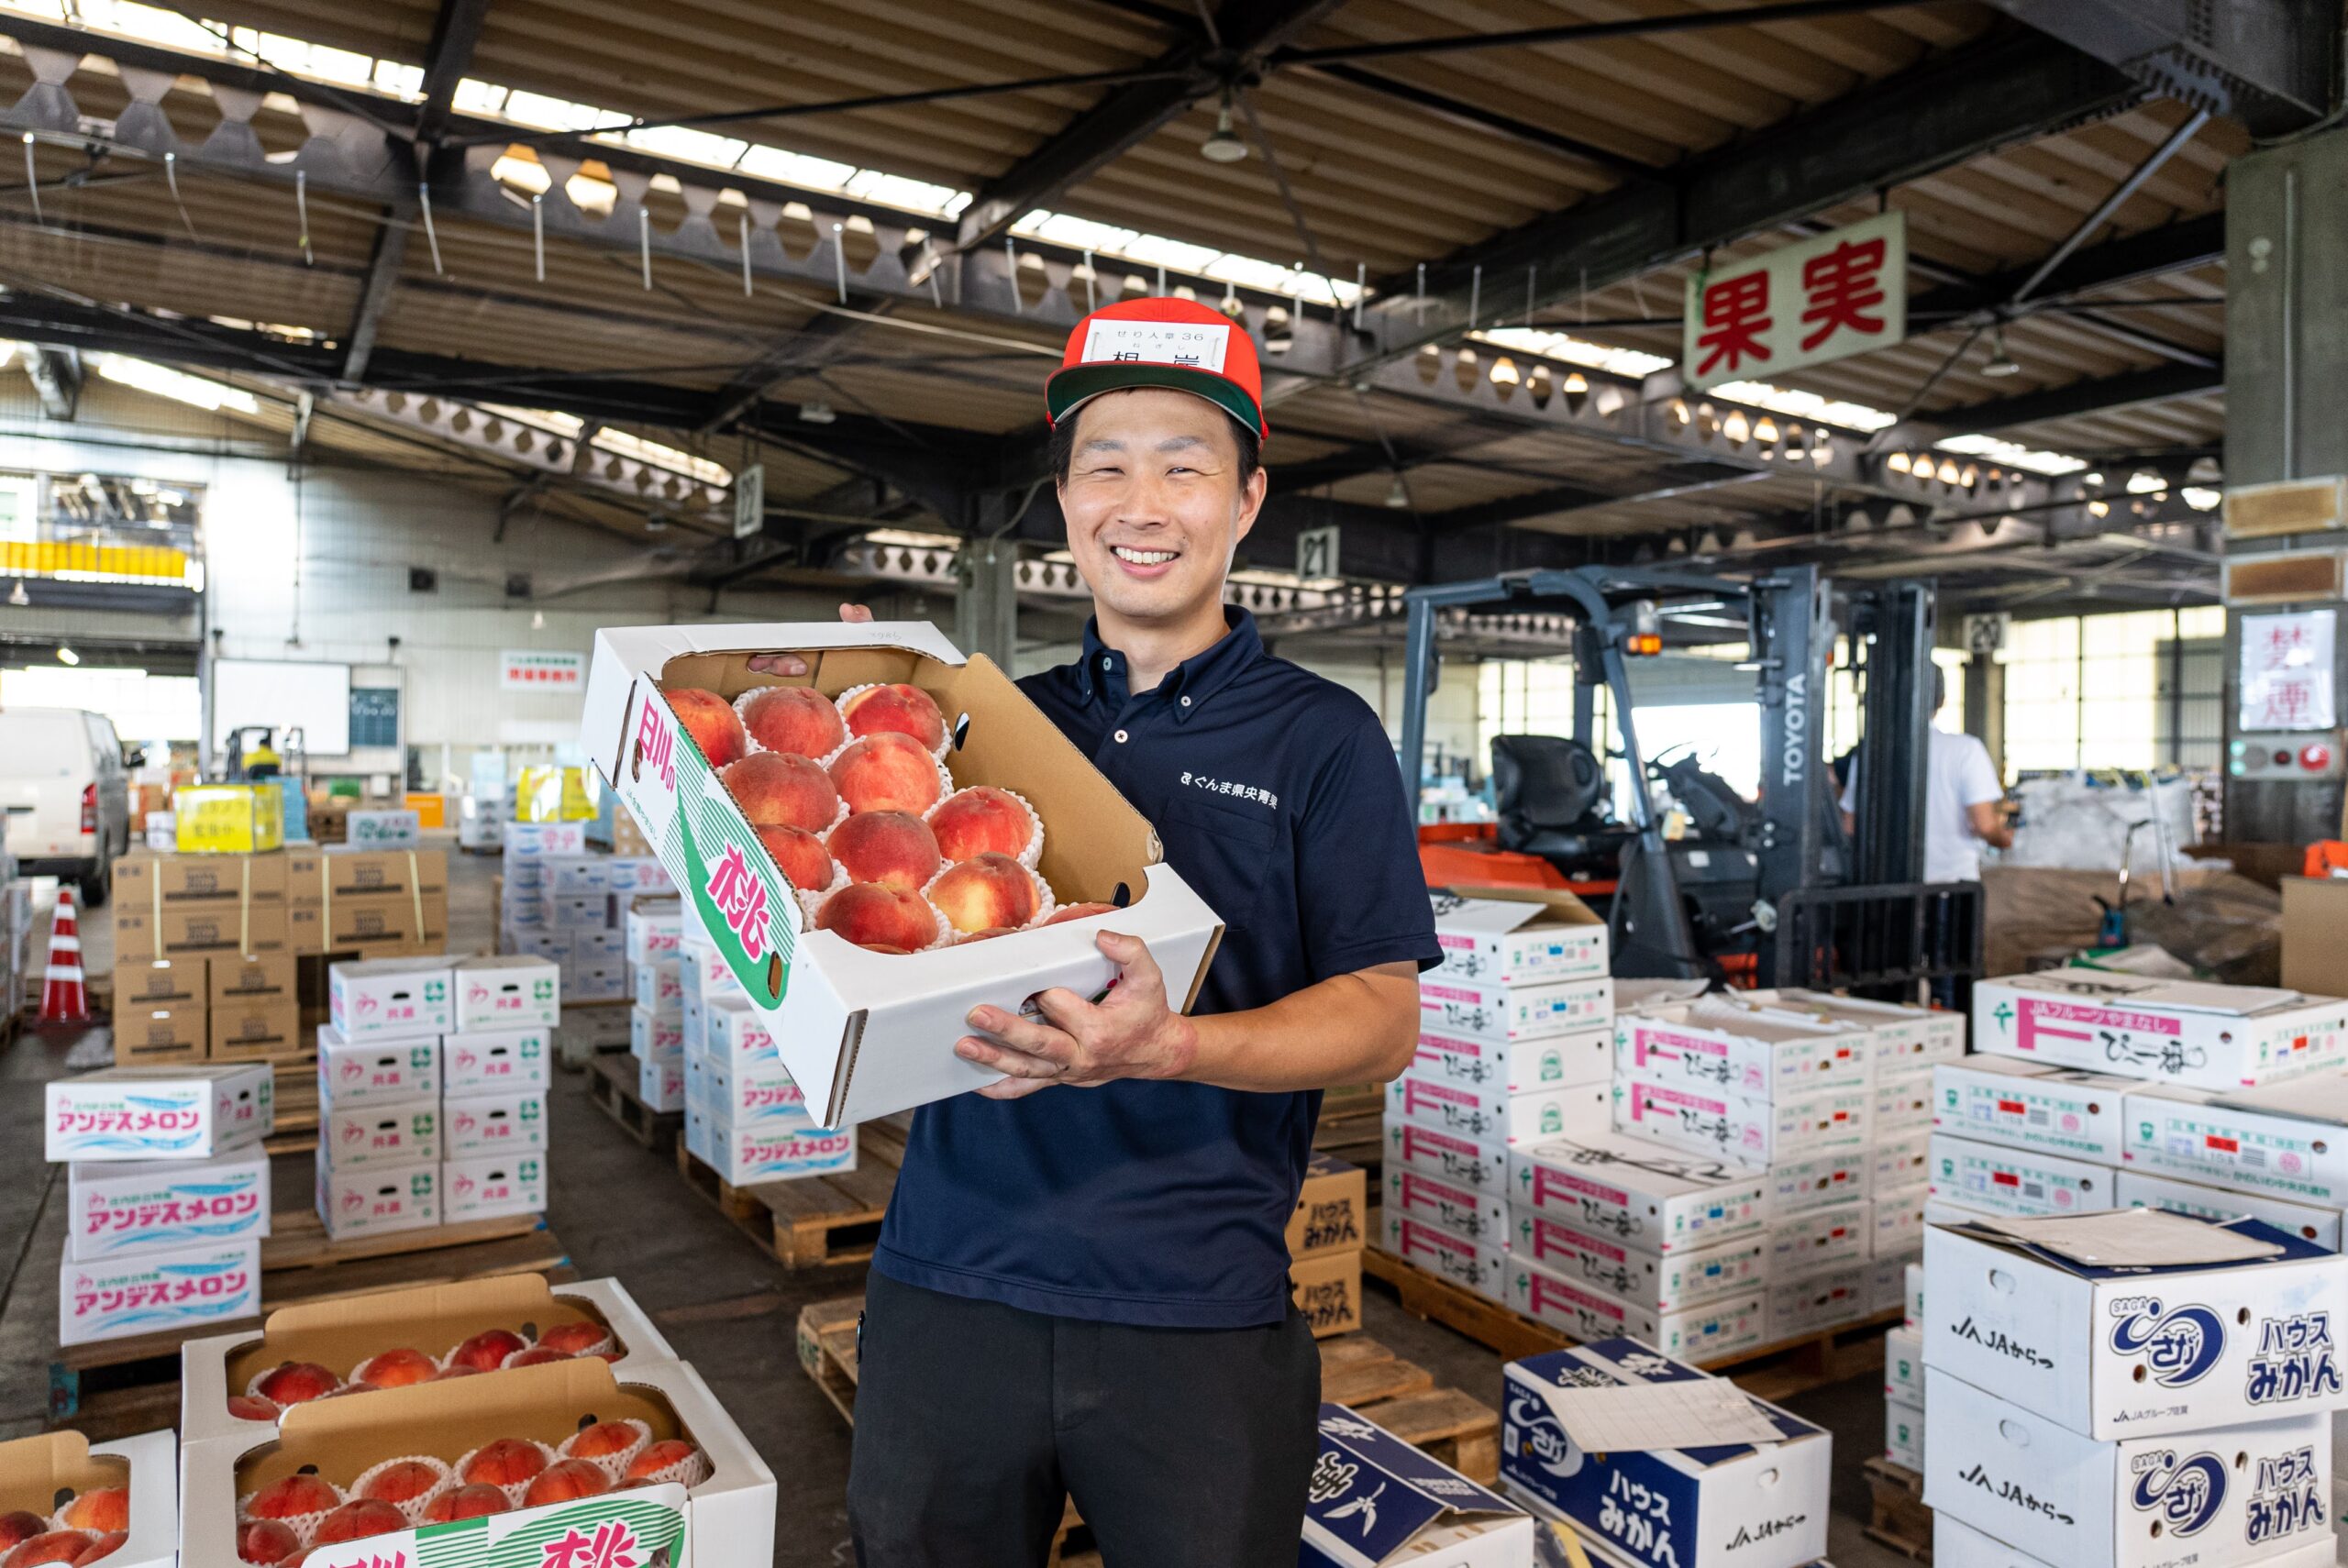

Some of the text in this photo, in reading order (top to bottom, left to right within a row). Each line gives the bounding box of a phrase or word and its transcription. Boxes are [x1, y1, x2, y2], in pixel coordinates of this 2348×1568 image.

[1696, 237, 1887, 377] 果実
[1303, 535, 1328, 577] 21
[1783, 672, 1807, 787] TOYOTA
[1194, 775, 1279, 810] ぐんま県央青果
[707, 842, 770, 960] 桃
[2030, 1001, 2170, 1033] JAフルーツやまなし
[743, 1084, 805, 1109] アンデス
[57, 1111, 200, 1132] アンデスメロン
[741, 1135, 849, 1165] アンデスメロン
[87, 1193, 258, 1235] アンデスメロン
[1311, 1198, 1354, 1222] ハウス
[1303, 1220, 1359, 1250] みかん
[74, 1272, 248, 1317] アンデスメロン
[1304, 1278, 1347, 1304] ハウス
[2112, 1300, 2147, 1313] SAGA
[1985, 1331, 2054, 1369] JAからつ
[2151, 1331, 2200, 1367] さが
[2260, 1313, 2331, 1354] ハウス
[2247, 1351, 2342, 1404] みかん
[2131, 1405, 2188, 1420] JAグループ佐賀
[1531, 1425, 1567, 1463] さが
[2134, 1455, 2163, 1468] SAGA
[2255, 1448, 2316, 1493] ハウス
[1610, 1469, 1672, 1527] ハウス
[1998, 1481, 2075, 1525] JAからつ
[2165, 1478, 2208, 1518] さが
[2247, 1485, 2324, 1542] みかん
[1599, 1495, 1680, 1568] みかん
[1754, 1514, 1807, 1541] JAからつ
